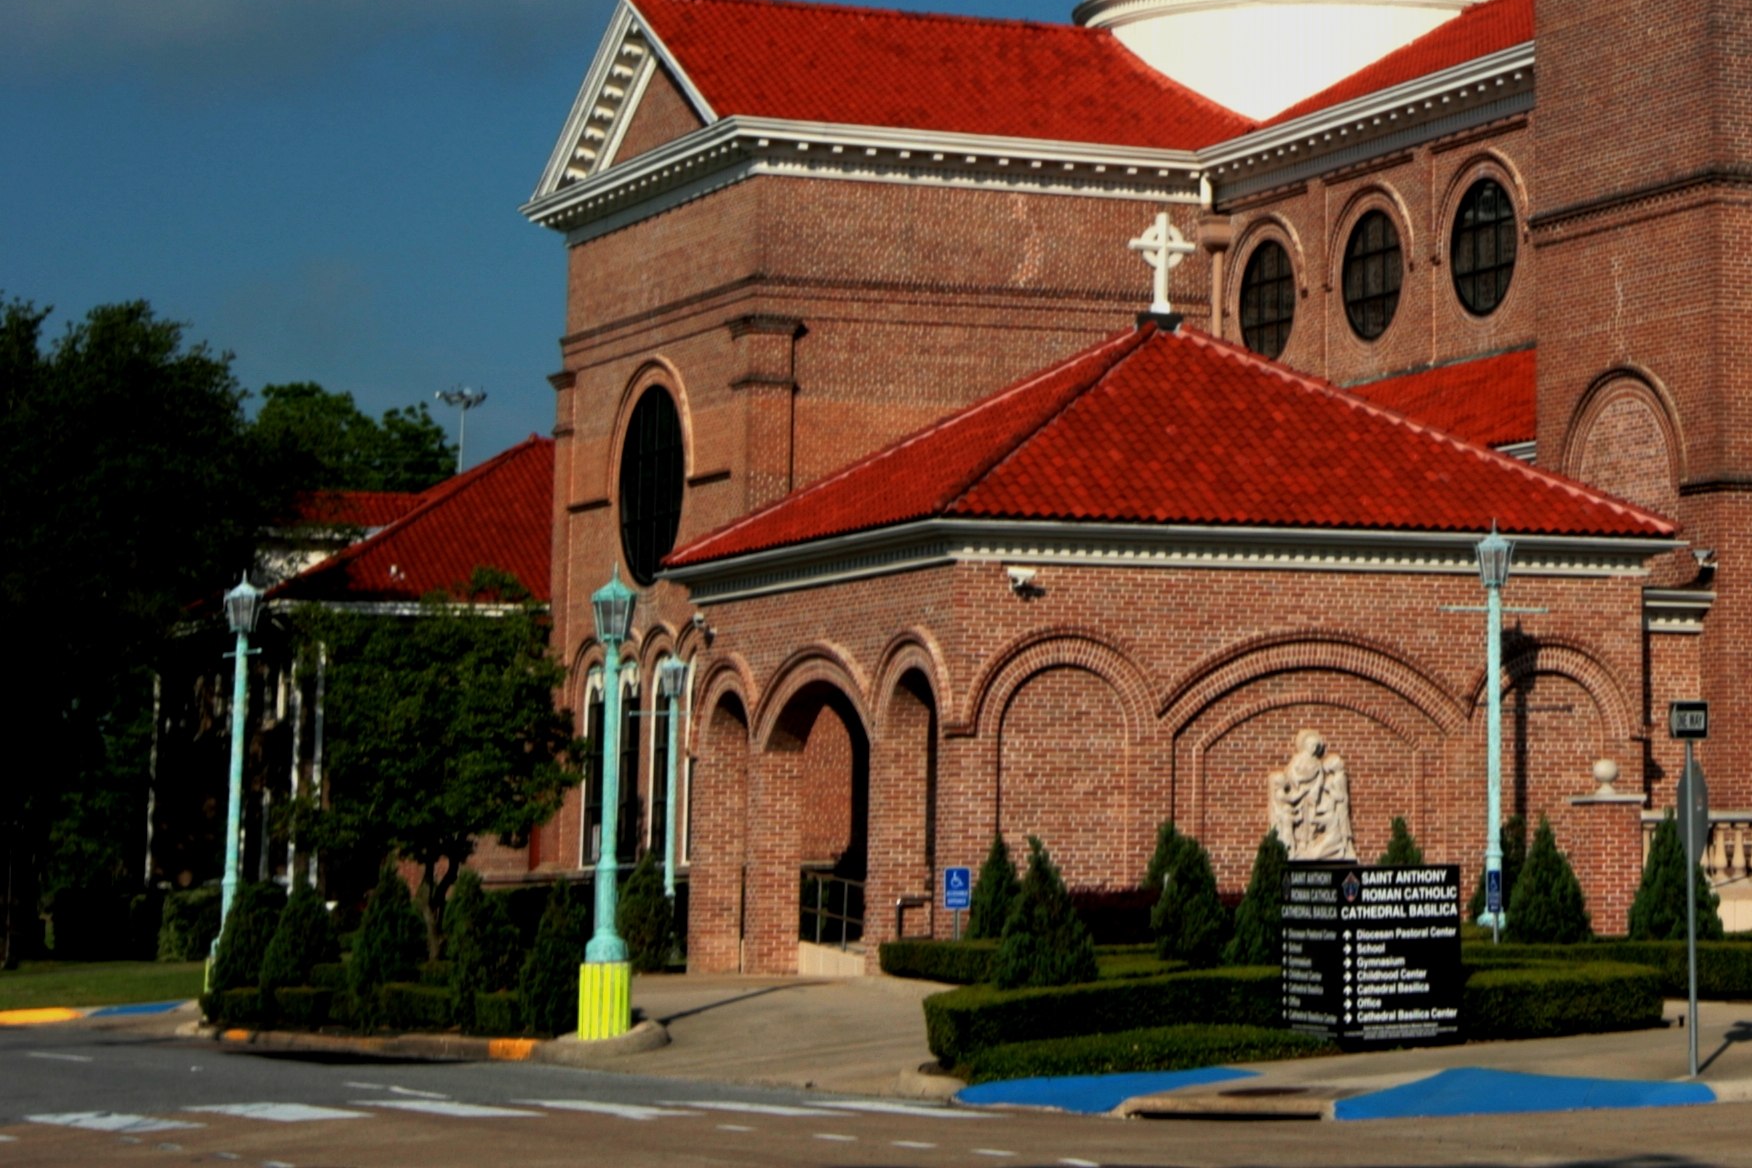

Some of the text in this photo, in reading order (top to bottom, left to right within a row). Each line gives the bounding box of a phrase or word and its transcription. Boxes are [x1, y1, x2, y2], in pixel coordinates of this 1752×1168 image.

[1361, 869, 1447, 885] SAINT ANTHONY
[1361, 885, 1457, 902] ROMAN CATHOLIC
[1341, 903, 1458, 920] CATHEDRAL BASILICA
[1357, 926, 1456, 941] Diocesan Pastoral Center
[1357, 942, 1385, 954] School
[1357, 955, 1405, 969] Gymnasium
[1357, 968, 1427, 981] Childhood Center
[1357, 981, 1430, 995] Cathedral Basilica
[1357, 996, 1382, 1009] Office
[1357, 1007, 1457, 1023] Cathedral Basilica Center
